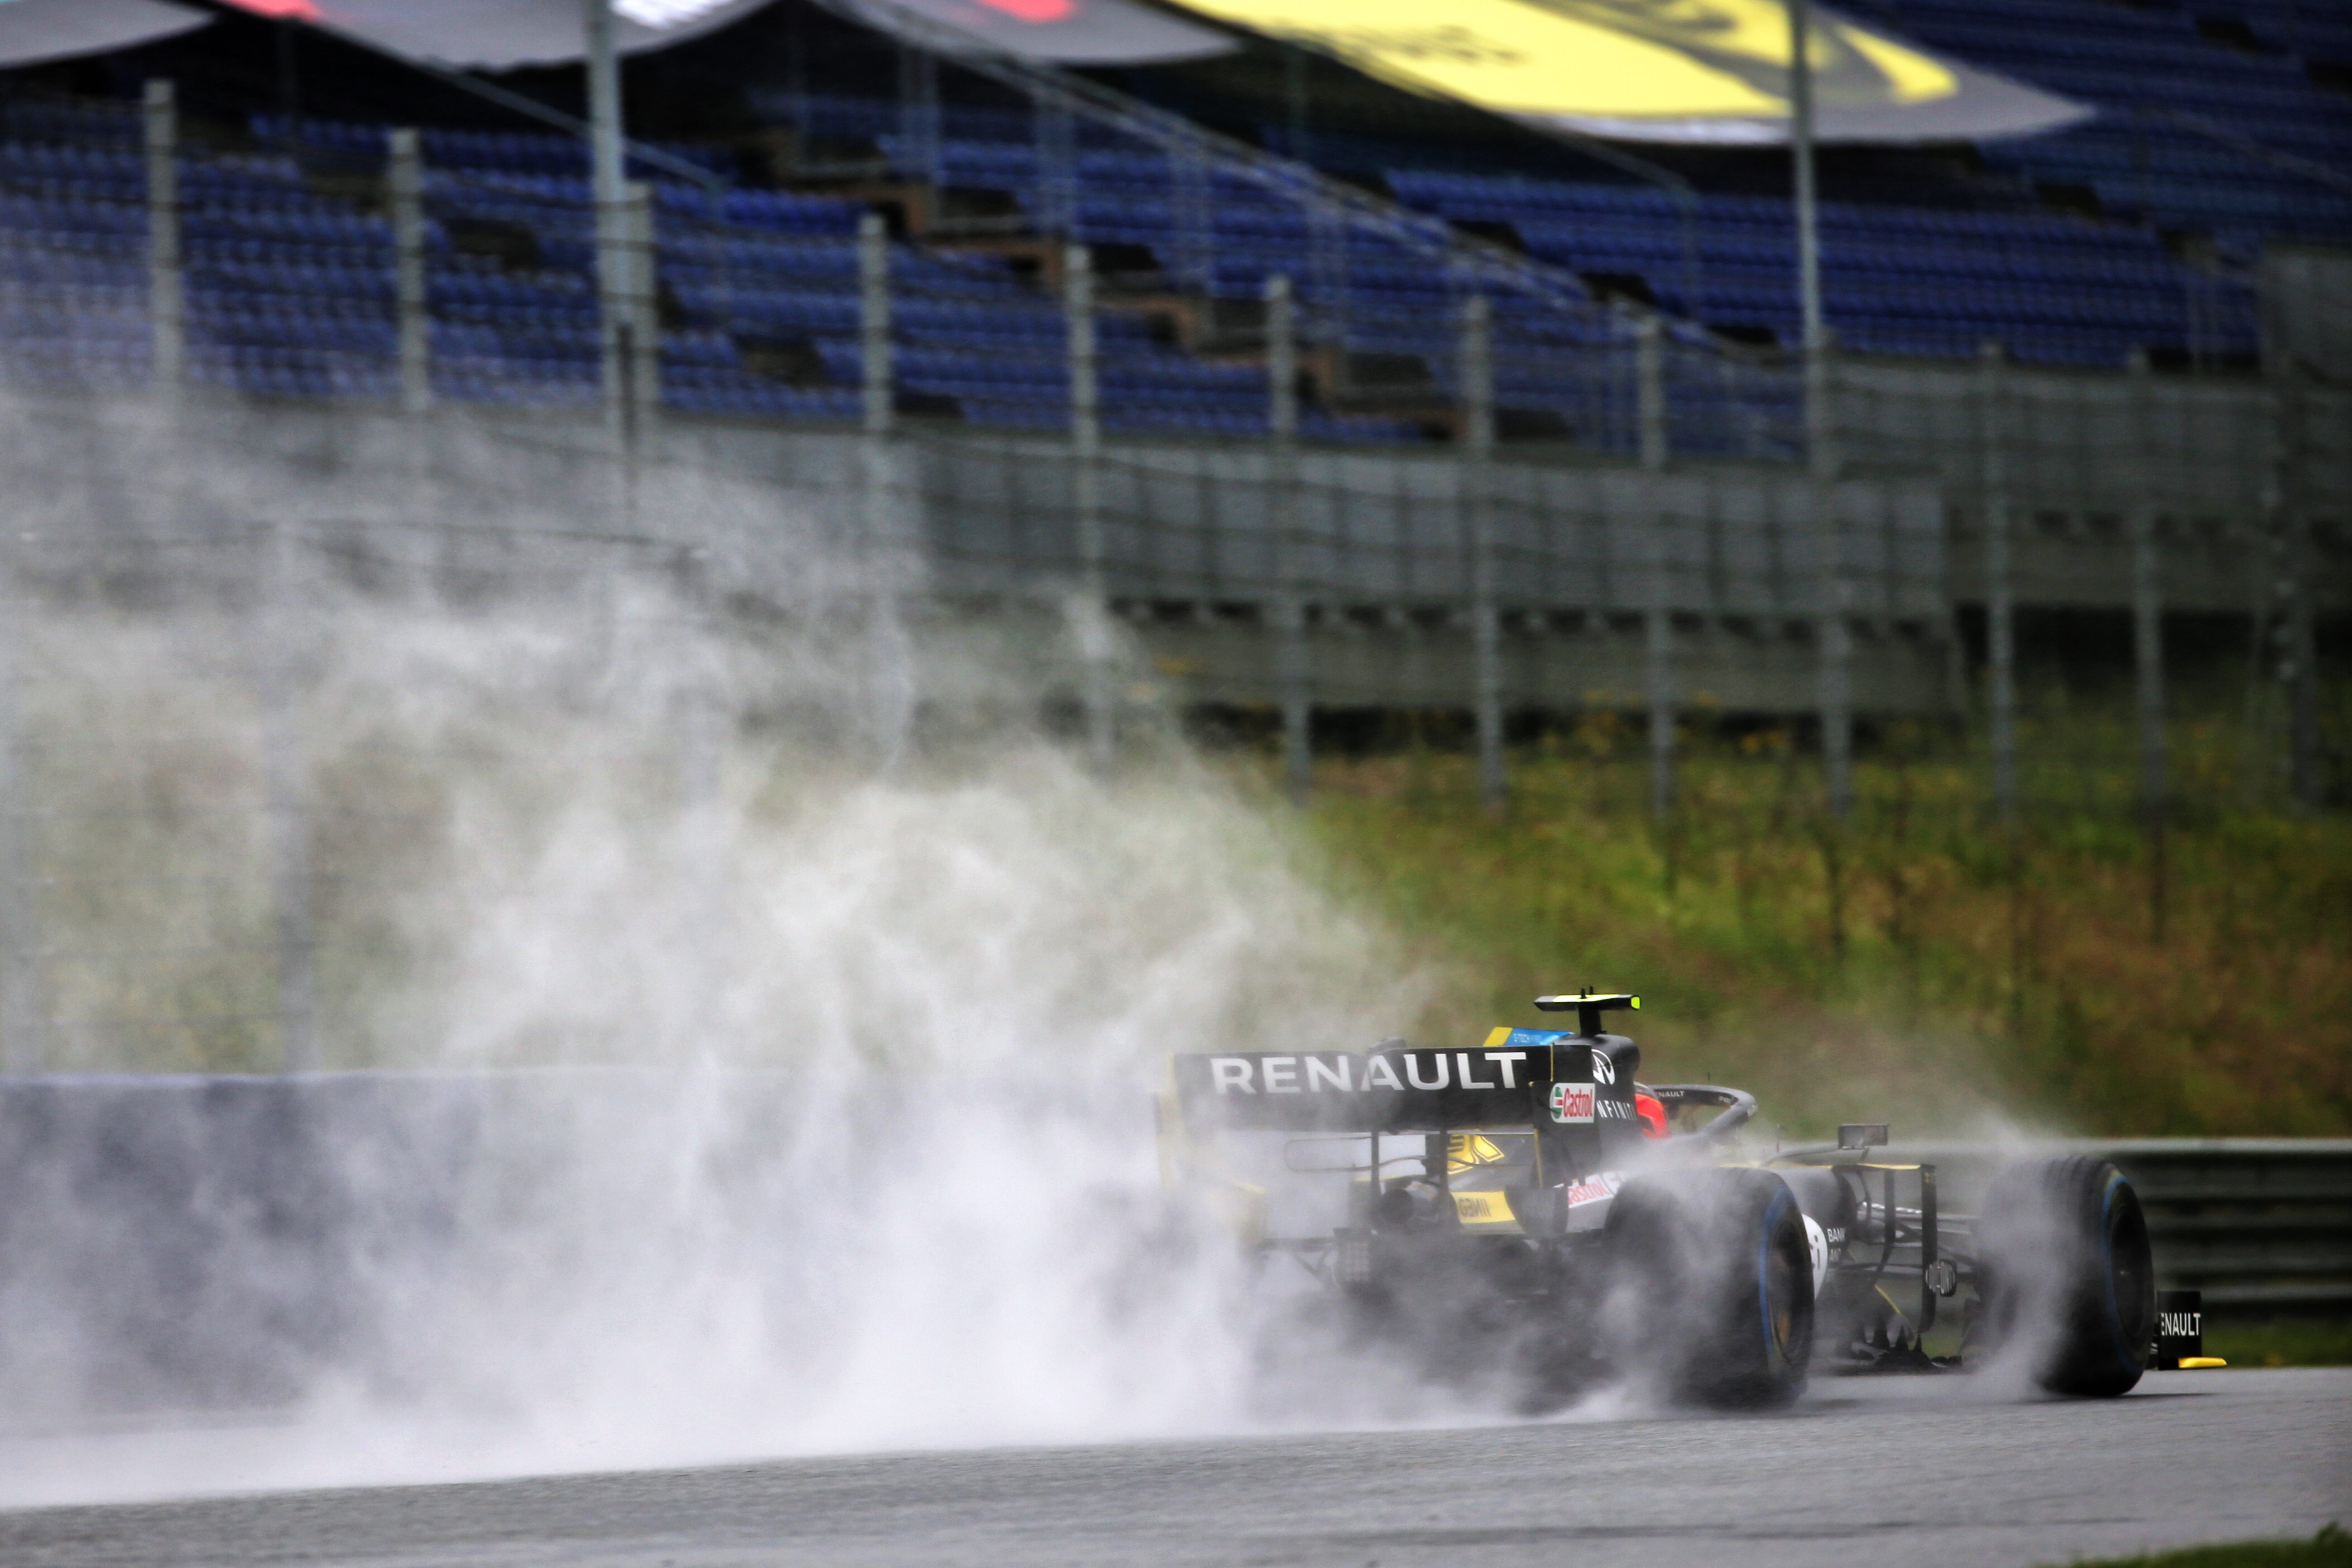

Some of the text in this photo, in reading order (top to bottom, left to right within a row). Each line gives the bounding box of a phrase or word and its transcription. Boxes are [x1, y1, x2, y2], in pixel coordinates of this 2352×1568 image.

[1210, 1052, 1527, 1094] RENAULT
[1563, 1088, 1592, 1117] Castrol
[1596, 1099, 1637, 1121] NFINITI
[2161, 1312, 2201, 1336] ENAULT
